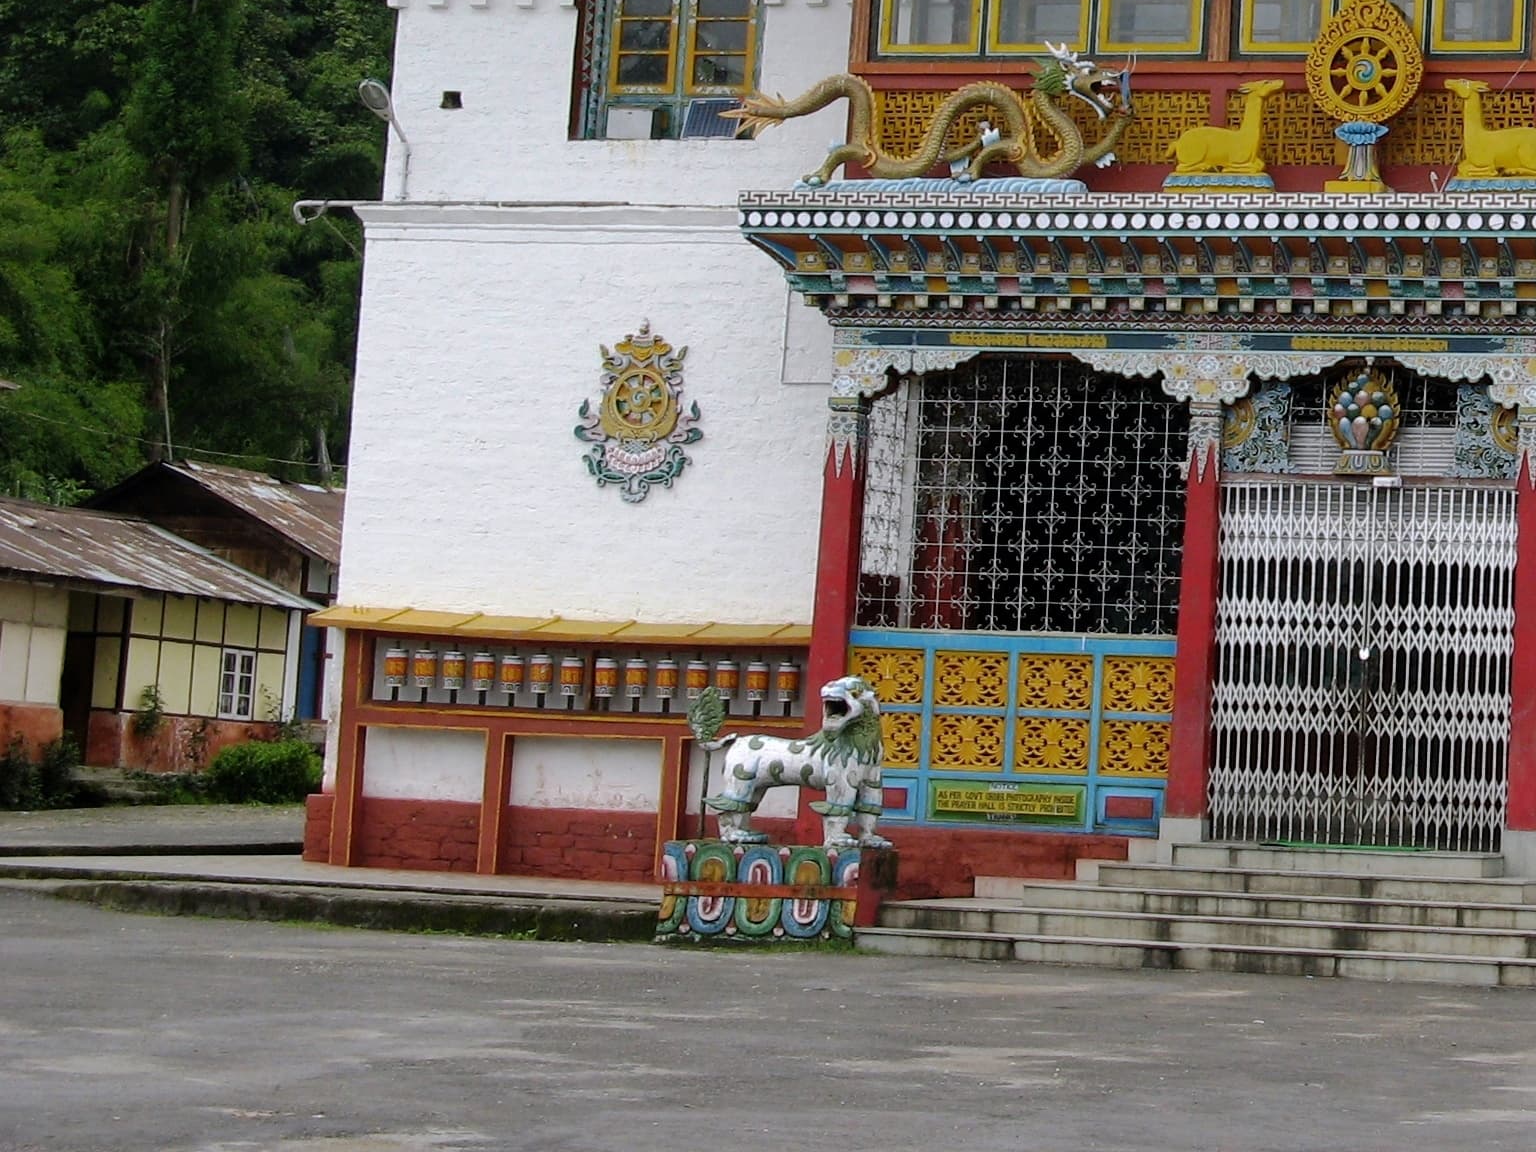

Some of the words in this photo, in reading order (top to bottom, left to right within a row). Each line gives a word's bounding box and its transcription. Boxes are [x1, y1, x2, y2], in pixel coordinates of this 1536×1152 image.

[938, 790, 948, 799] AS
[949, 791, 961, 799] PER
[1006, 793, 1052, 803] PHOTOGRAPHY
[937, 799, 950, 808] THE
[951, 800, 976, 809] PRAYER
[978, 801, 995, 810] HALL
[1007, 803, 1036, 812] STRICTLY
